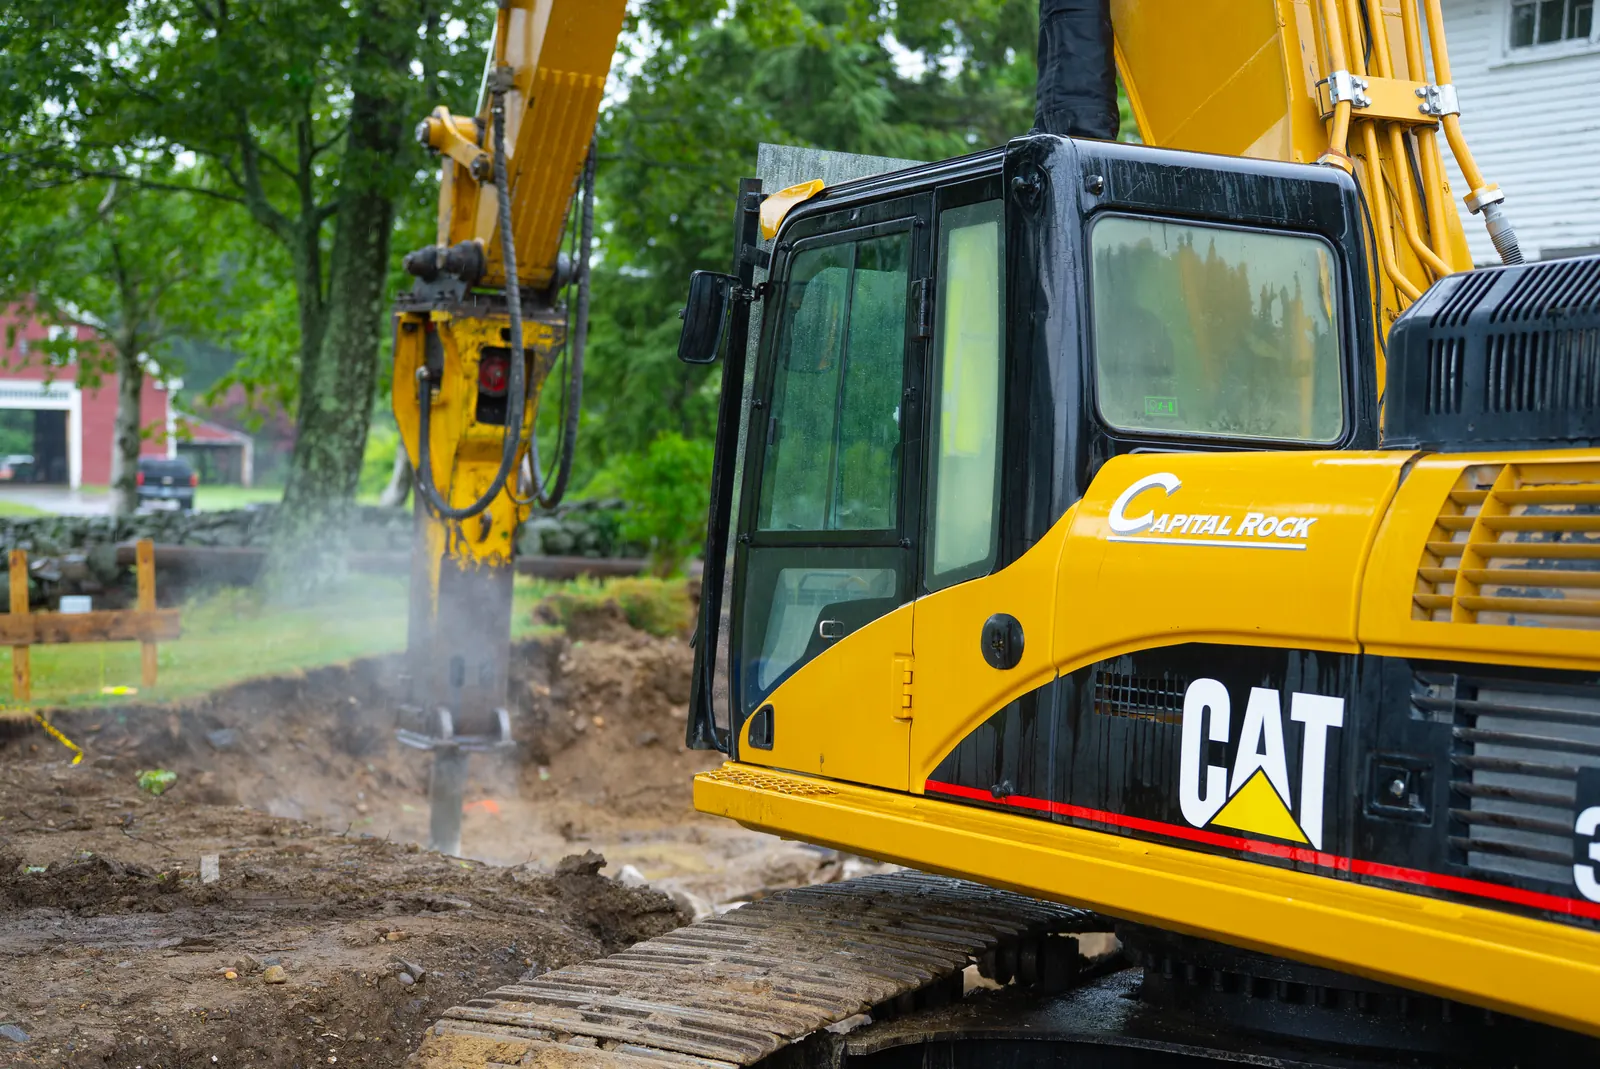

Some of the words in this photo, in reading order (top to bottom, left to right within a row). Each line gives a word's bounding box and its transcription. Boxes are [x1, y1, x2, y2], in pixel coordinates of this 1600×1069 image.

[1108, 472, 1231, 536] CAPITAL
[1236, 512, 1318, 538] ROCK
[1179, 677, 1345, 851] CAT
